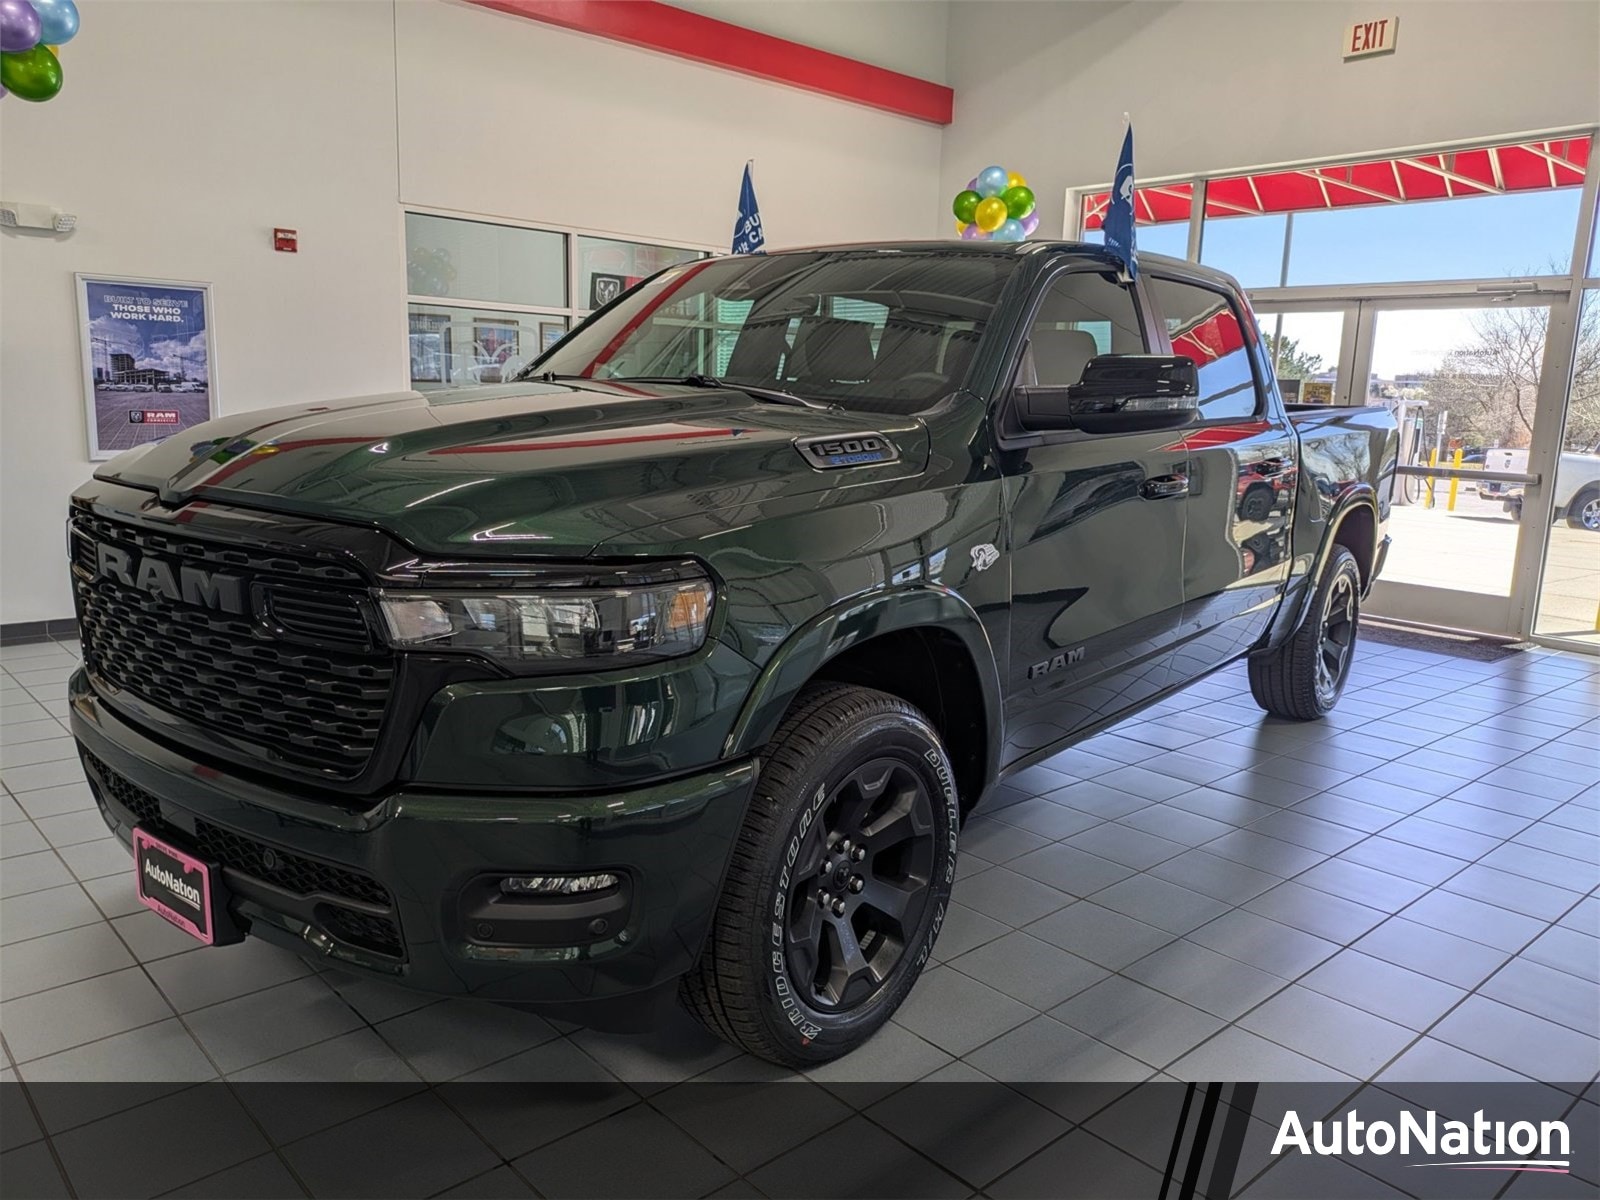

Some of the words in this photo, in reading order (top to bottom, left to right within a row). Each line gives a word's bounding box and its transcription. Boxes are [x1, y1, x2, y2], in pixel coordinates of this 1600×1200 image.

[1351, 19, 1388, 52] EXIT
[103, 295, 134, 304] BUILT
[136, 297, 152, 306] TO
[153, 298, 188, 308] SERVE
[110, 311, 147, 320] WORK
[148, 314, 184, 323] HARD.
[112, 304, 151, 313] THOSE
[152, 306, 181, 315] WHO
[811, 439, 881, 456] 1500
[97, 541, 245, 616] RAM
[1028, 646, 1086, 680] RAM
[145, 858, 202, 905] AutoNation
[771, 782, 827, 1041] BRIDGESTONE
